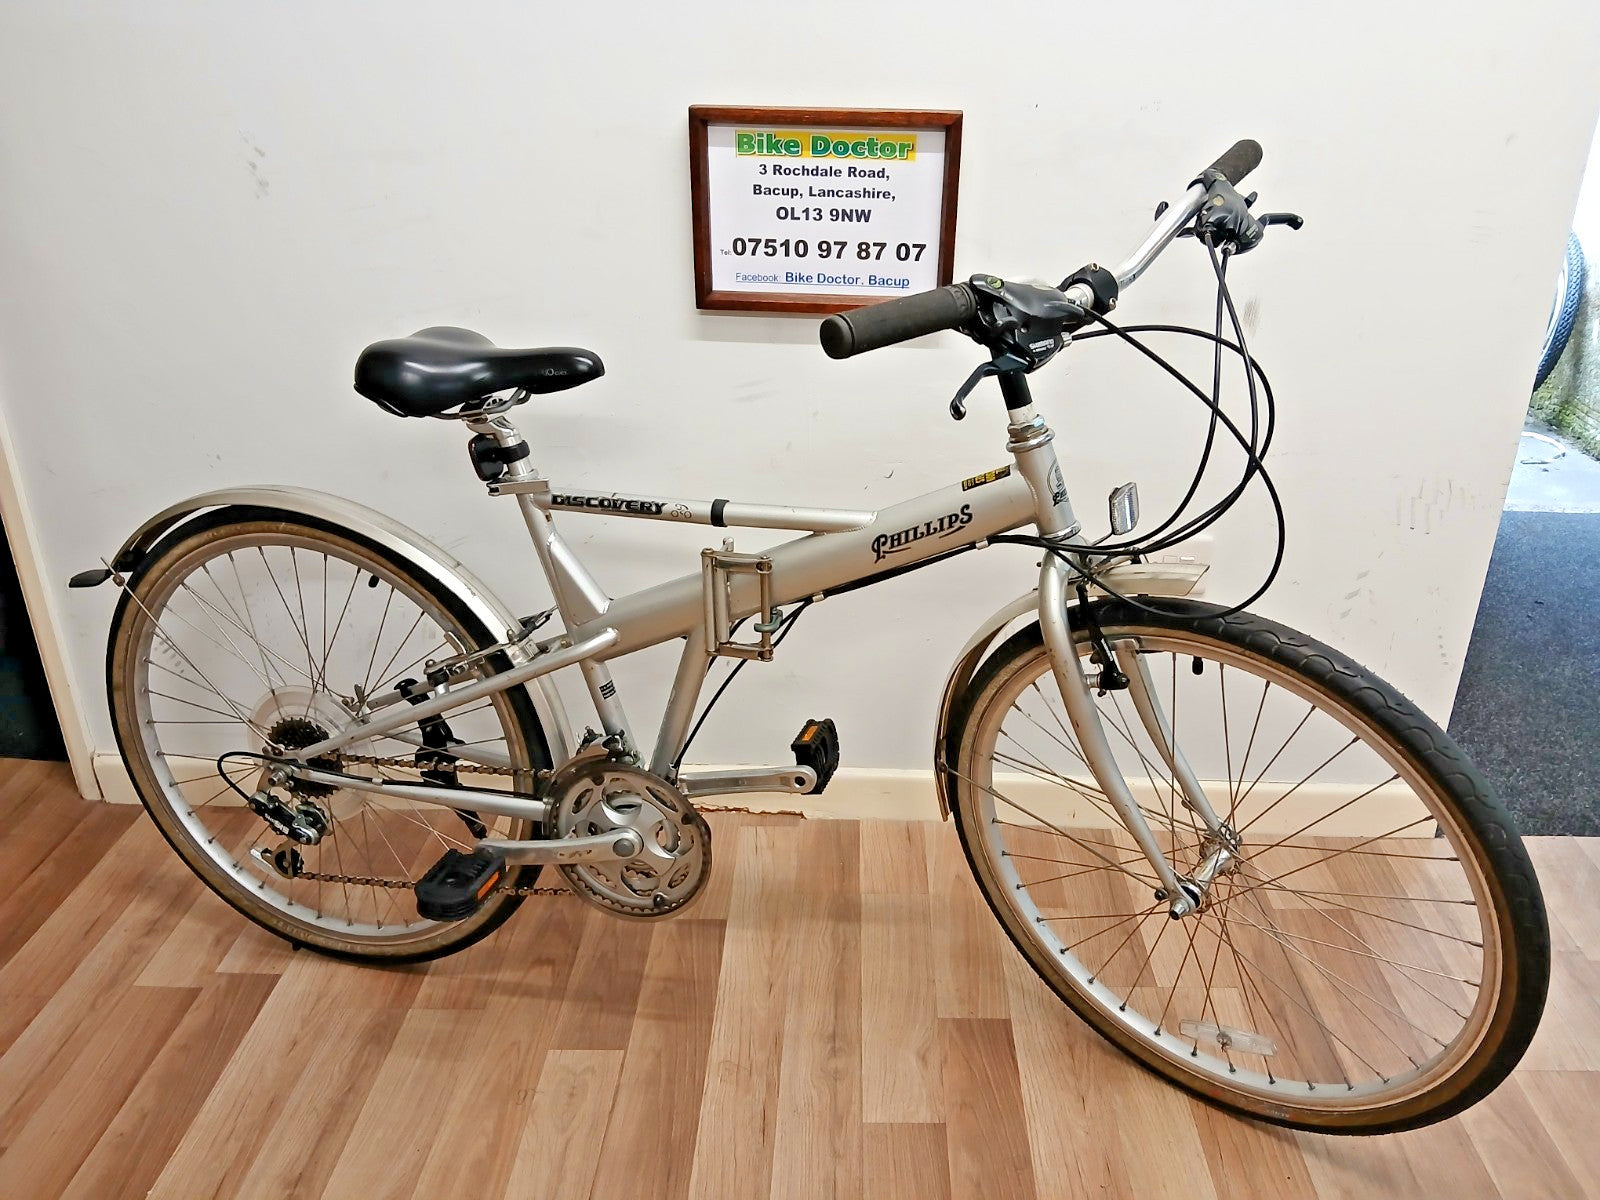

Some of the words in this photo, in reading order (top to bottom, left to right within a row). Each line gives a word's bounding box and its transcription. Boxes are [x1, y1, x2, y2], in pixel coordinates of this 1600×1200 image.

[736, 132, 802, 156] Bike
[811, 135, 914, 160] Doctor
[758, 164, 768, 176] 3
[772, 164, 843, 177] Rochdale
[847, 166, 890, 180] Road,
[752, 184, 803, 199] Bacup,
[808, 186, 896, 201] Lancashire,
[776, 206, 823, 221] OL13
[829, 208, 872, 223] 9NW
[732, 237, 808, 258] 07510
[817, 240, 848, 260] 97
[856, 241, 888, 261] 87
[895, 243, 927, 262] 07
[785, 272, 814, 283] Bike
[868, 275, 910, 288] Bacup
[551, 493, 668, 515] DISCOVERY
[872, 504, 974, 564] PHILLIPS
